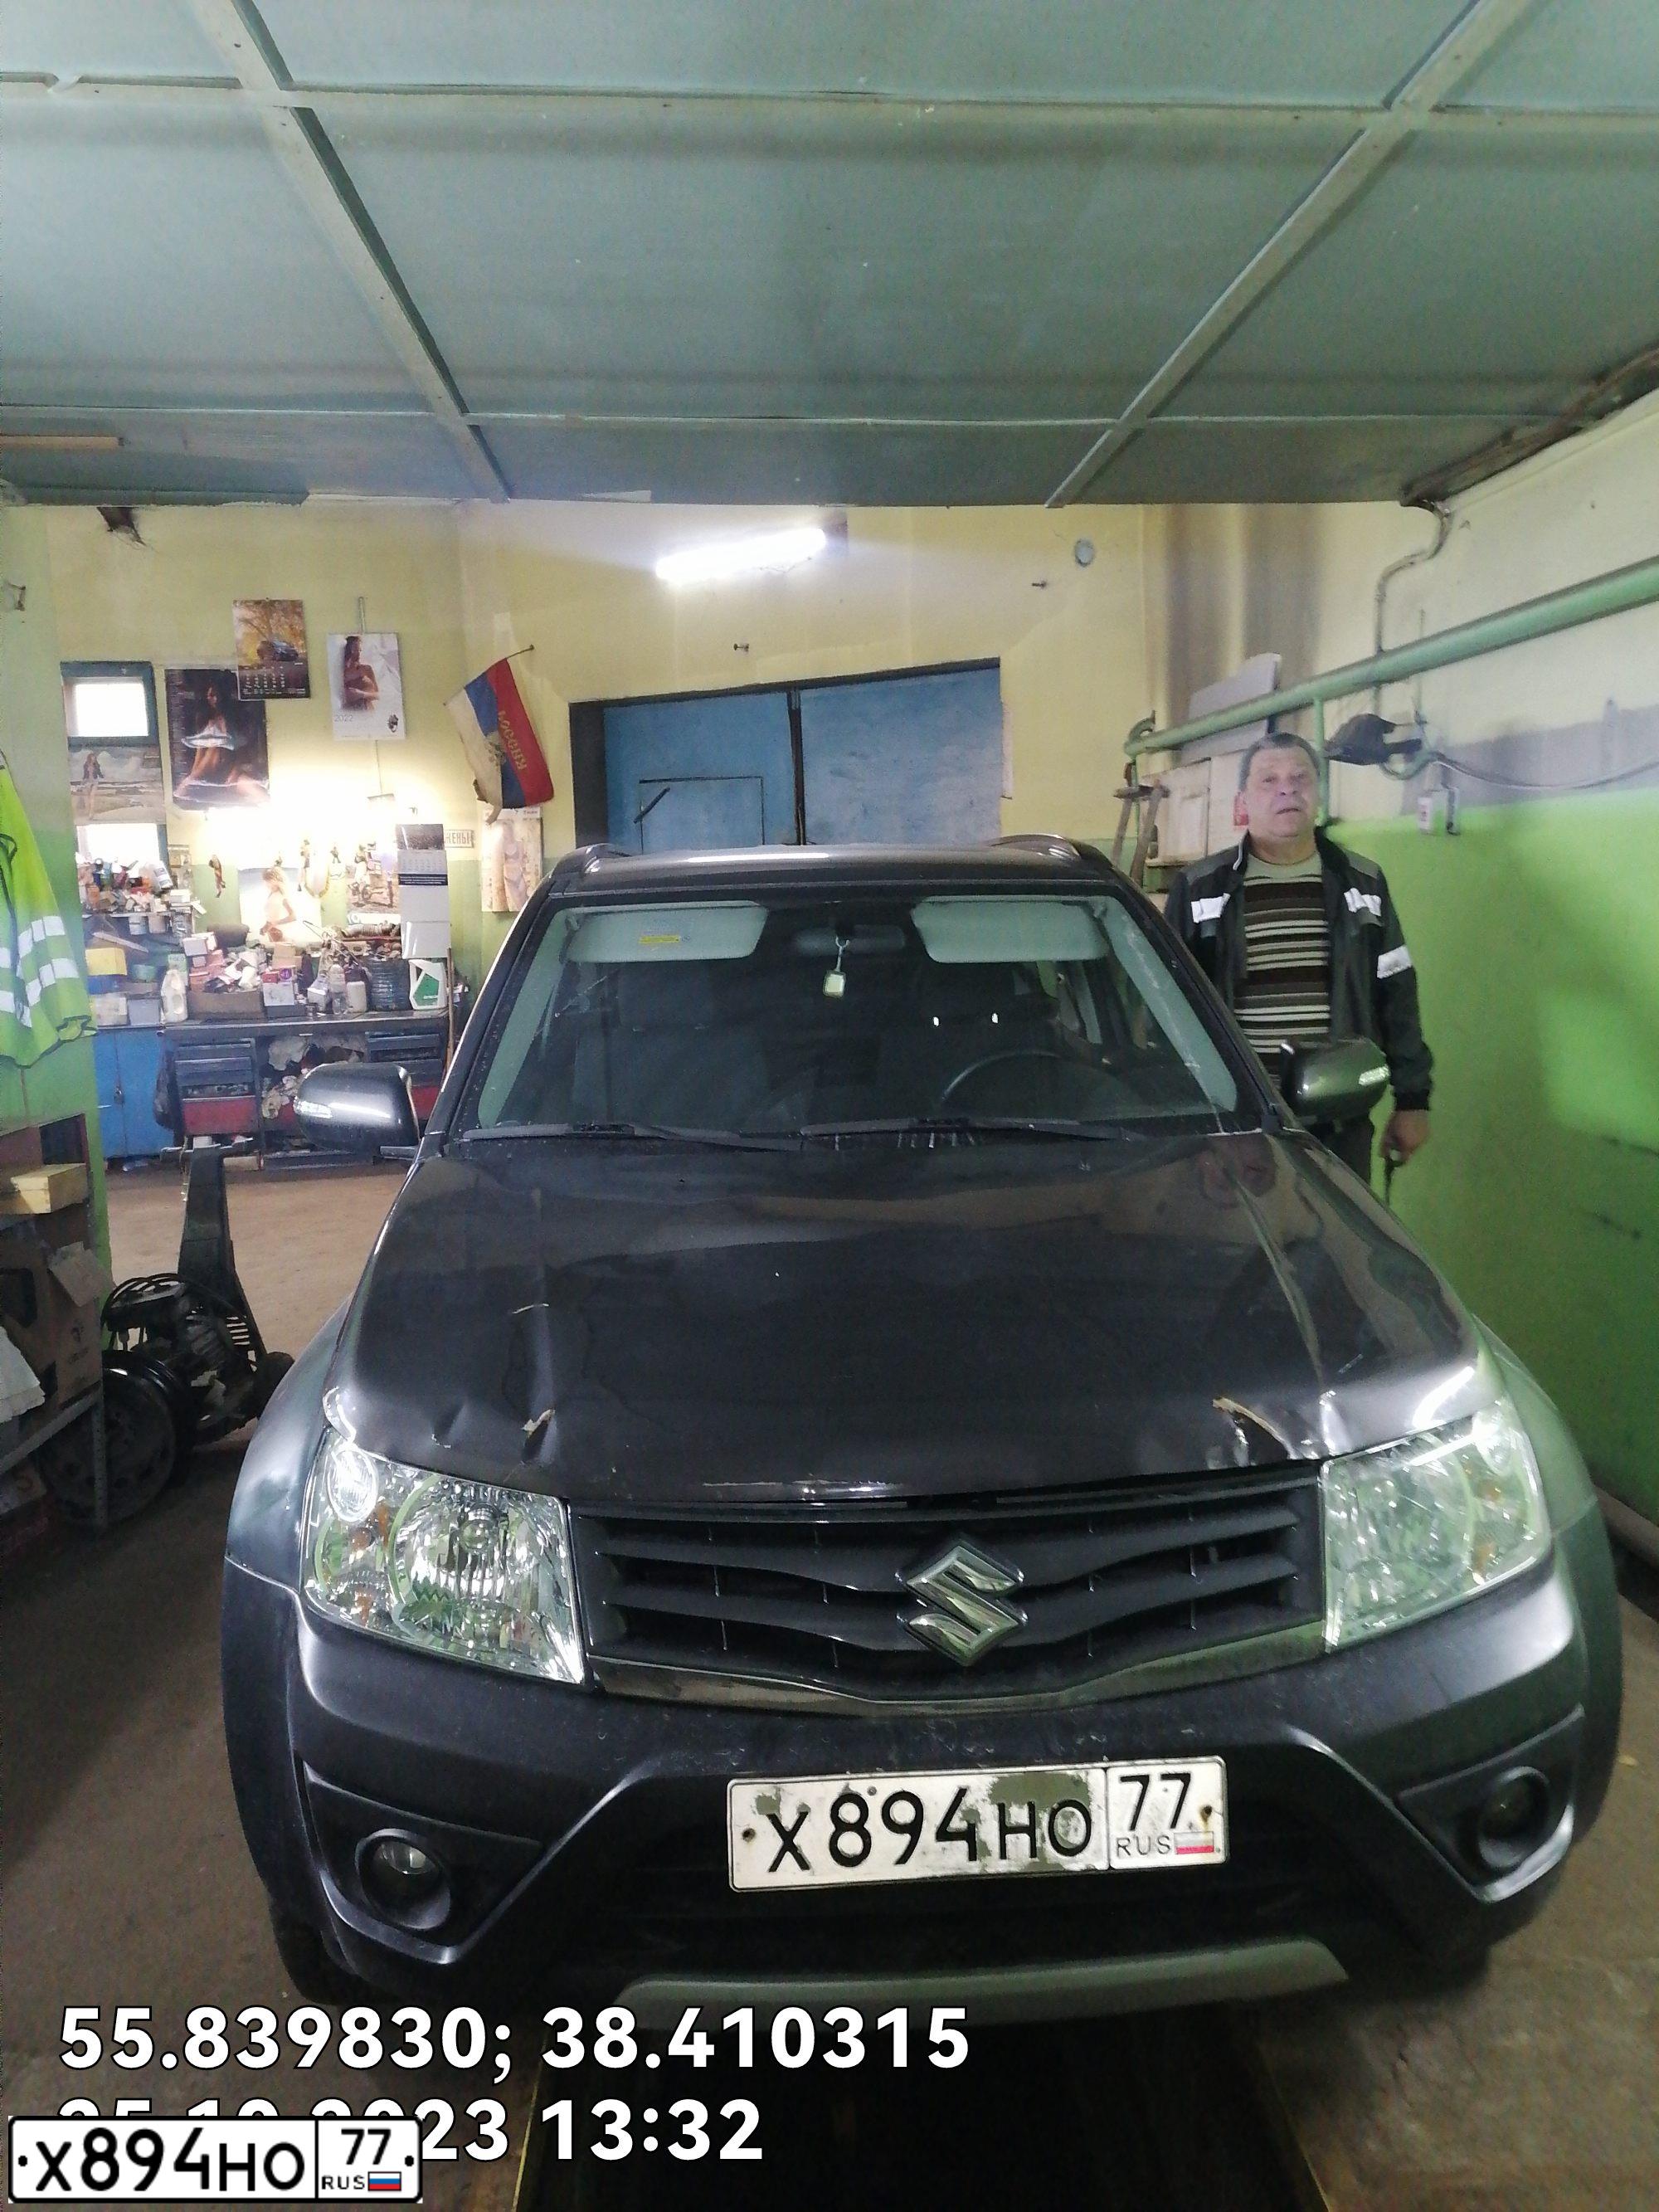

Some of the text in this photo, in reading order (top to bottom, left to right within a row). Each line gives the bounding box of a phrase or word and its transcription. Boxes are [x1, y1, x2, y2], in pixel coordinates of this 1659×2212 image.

[766, 1786, 1093, 1873] Х894НО
[1118, 1772, 1192, 1831] 77
[1115, 1834, 1172, 1859] RUS
